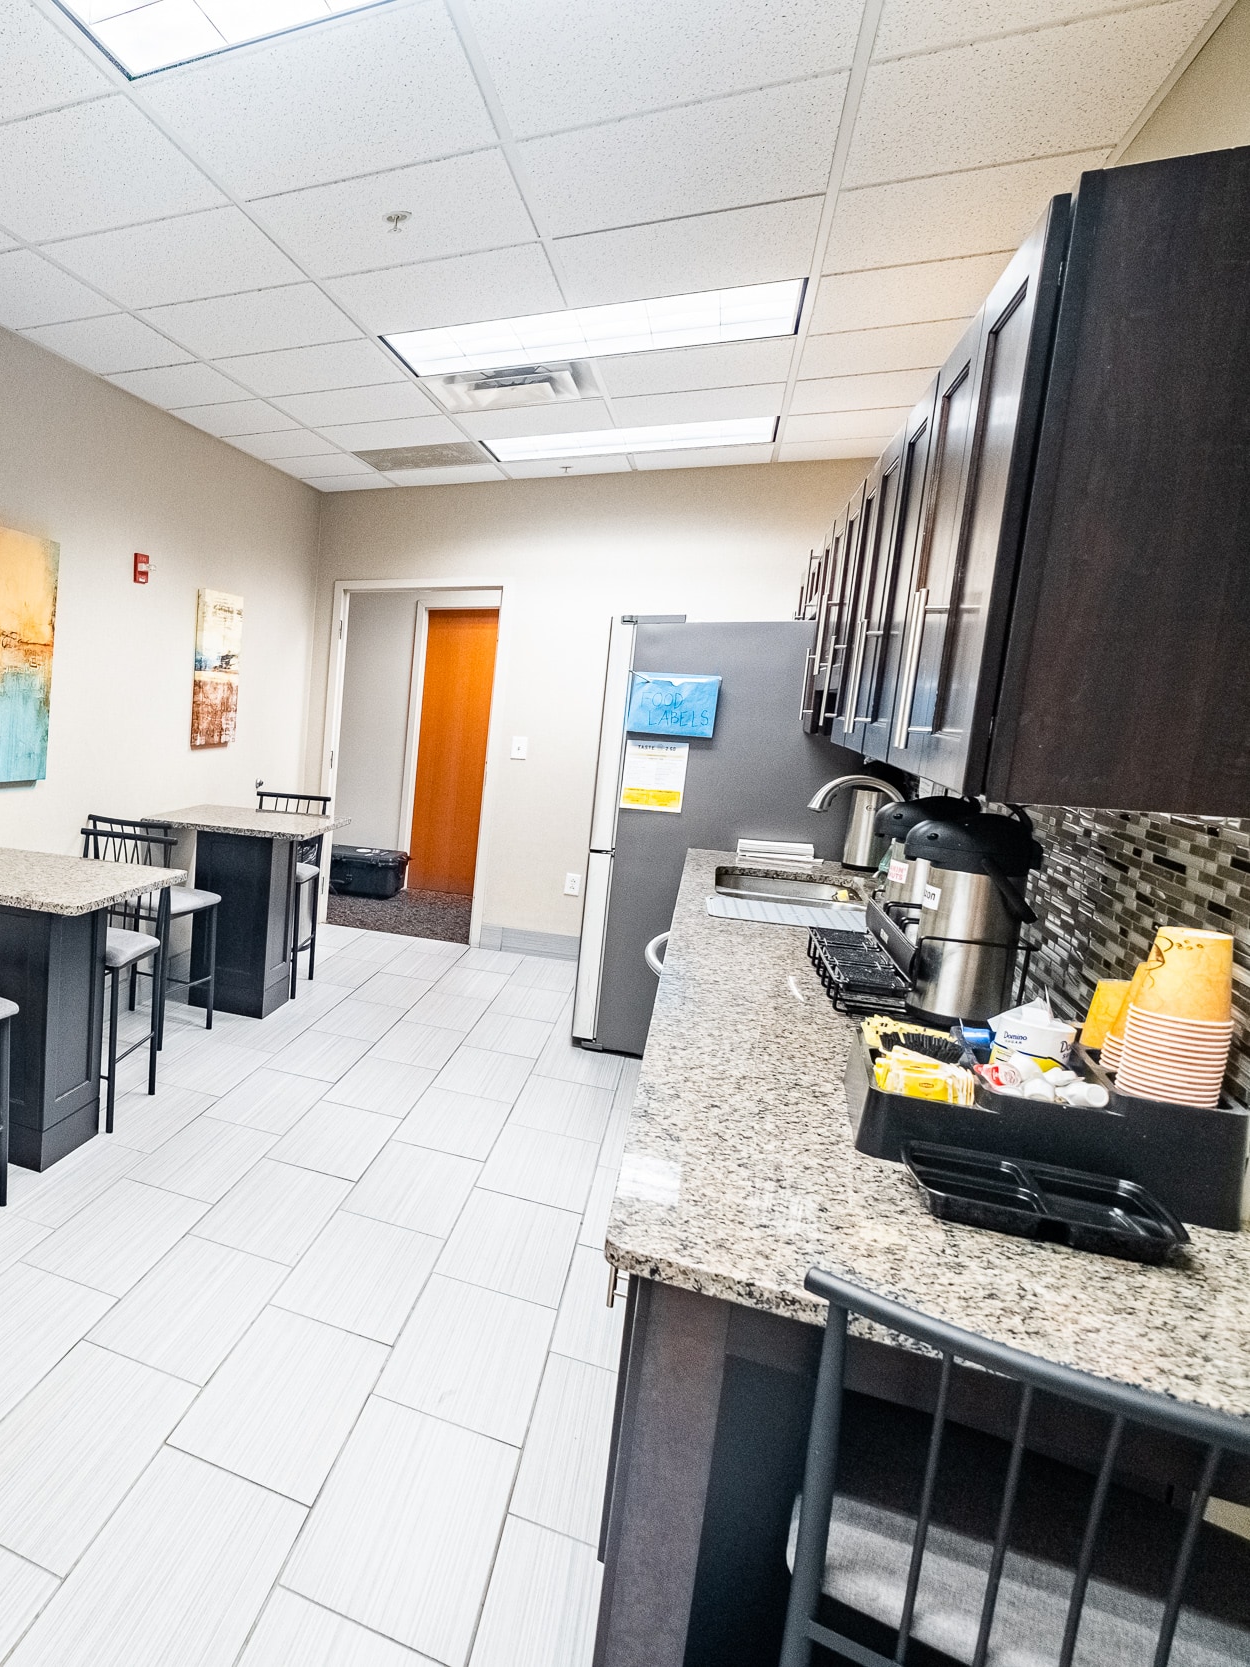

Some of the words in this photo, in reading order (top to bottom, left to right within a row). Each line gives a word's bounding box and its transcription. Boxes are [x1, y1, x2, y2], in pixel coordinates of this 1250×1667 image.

[639, 692, 684, 709] FOOD
[648, 709, 709, 727] LABELS
[1003, 1031, 1028, 1041] Domino
